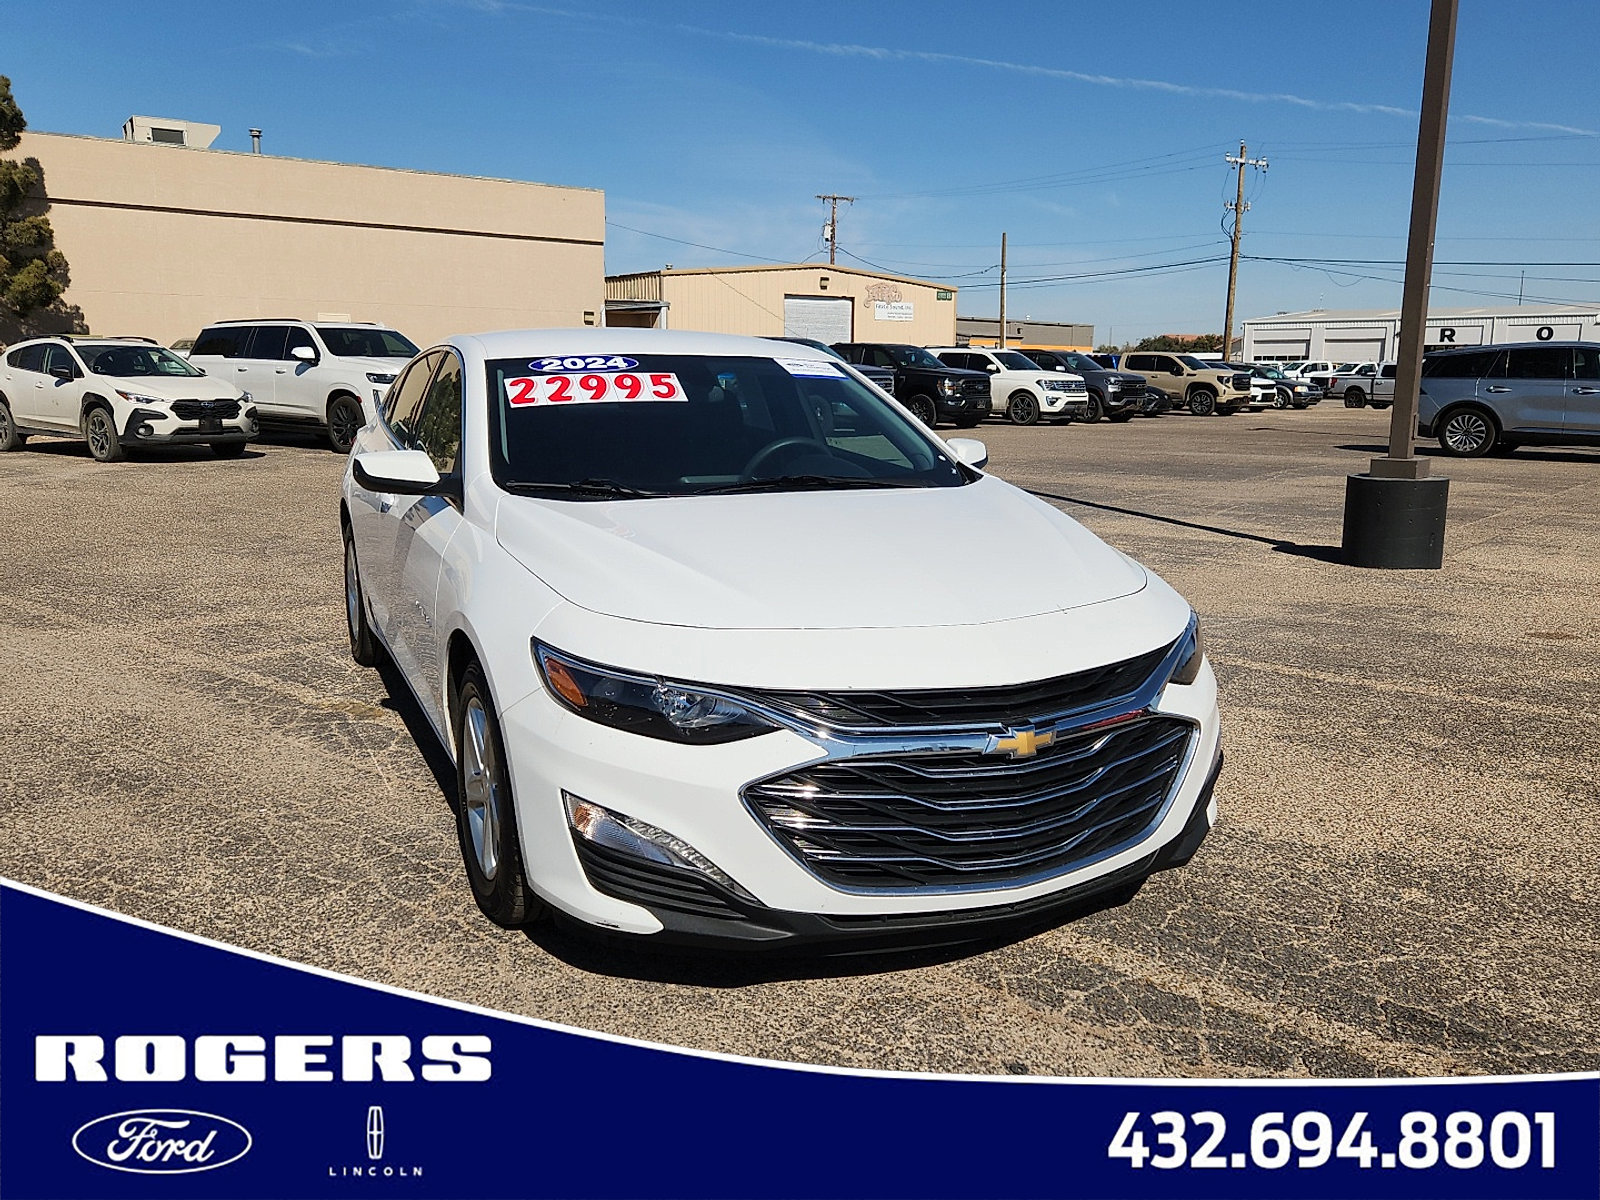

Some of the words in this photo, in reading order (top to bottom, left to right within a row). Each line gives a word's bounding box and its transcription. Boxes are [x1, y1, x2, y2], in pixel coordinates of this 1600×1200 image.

[1439, 328, 1456, 342] R
[1536, 326, 1554, 341] O
[541, 357, 628, 371] 2024
[510, 374, 676, 405] 22995
